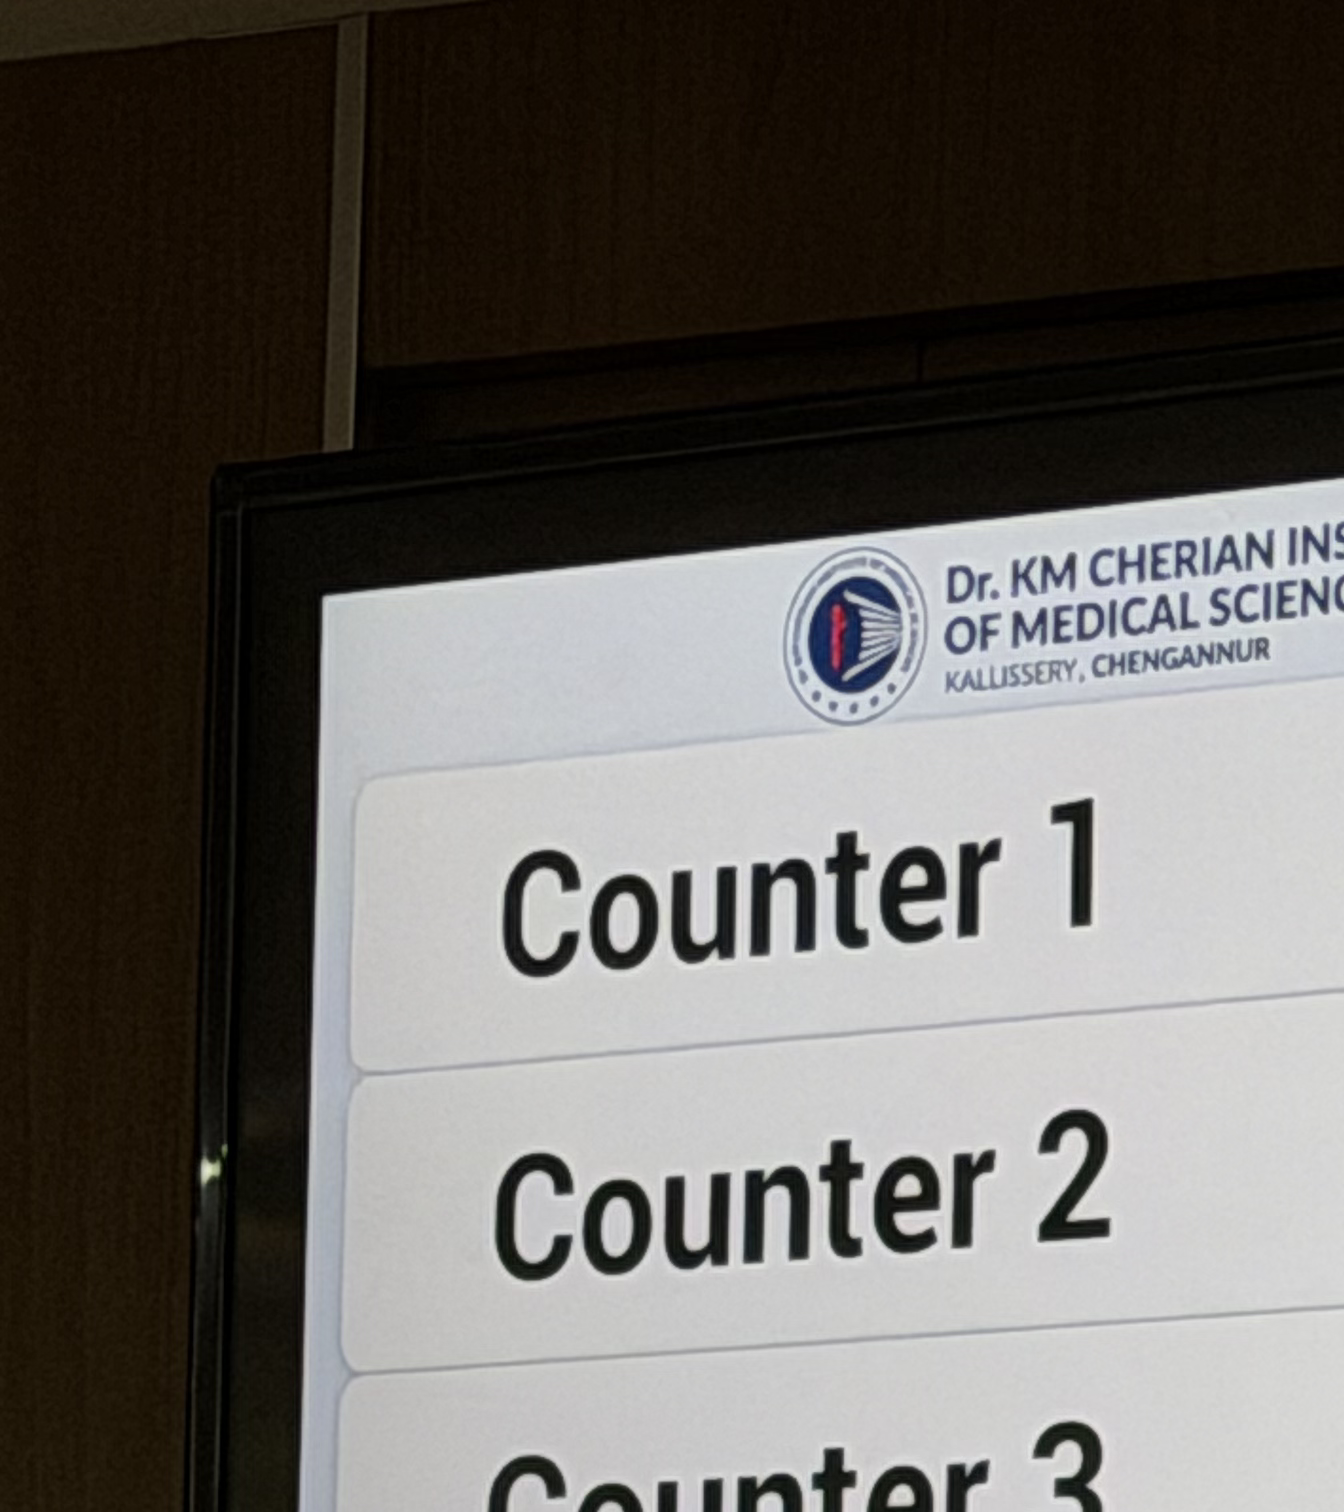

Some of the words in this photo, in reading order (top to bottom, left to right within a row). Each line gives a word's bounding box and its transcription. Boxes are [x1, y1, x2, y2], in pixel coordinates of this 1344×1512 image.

[946, 565, 1000, 604] Dr.
[1011, 552, 1077, 598] KM
[1088, 529, 1275, 587] CHERIAN
[943, 612, 1002, 655] OF
[1011, 591, 1201, 649] MEDICAL
[945, 658, 1086, 693] KALLISSERY,
[1091, 636, 1270, 678] CHENGANNUR
[502, 830, 1002, 978] Counter
[1051, 798, 1094, 928] 1
[494, 1139, 996, 1282] Counter
[1037, 1109, 1111, 1243] 2
